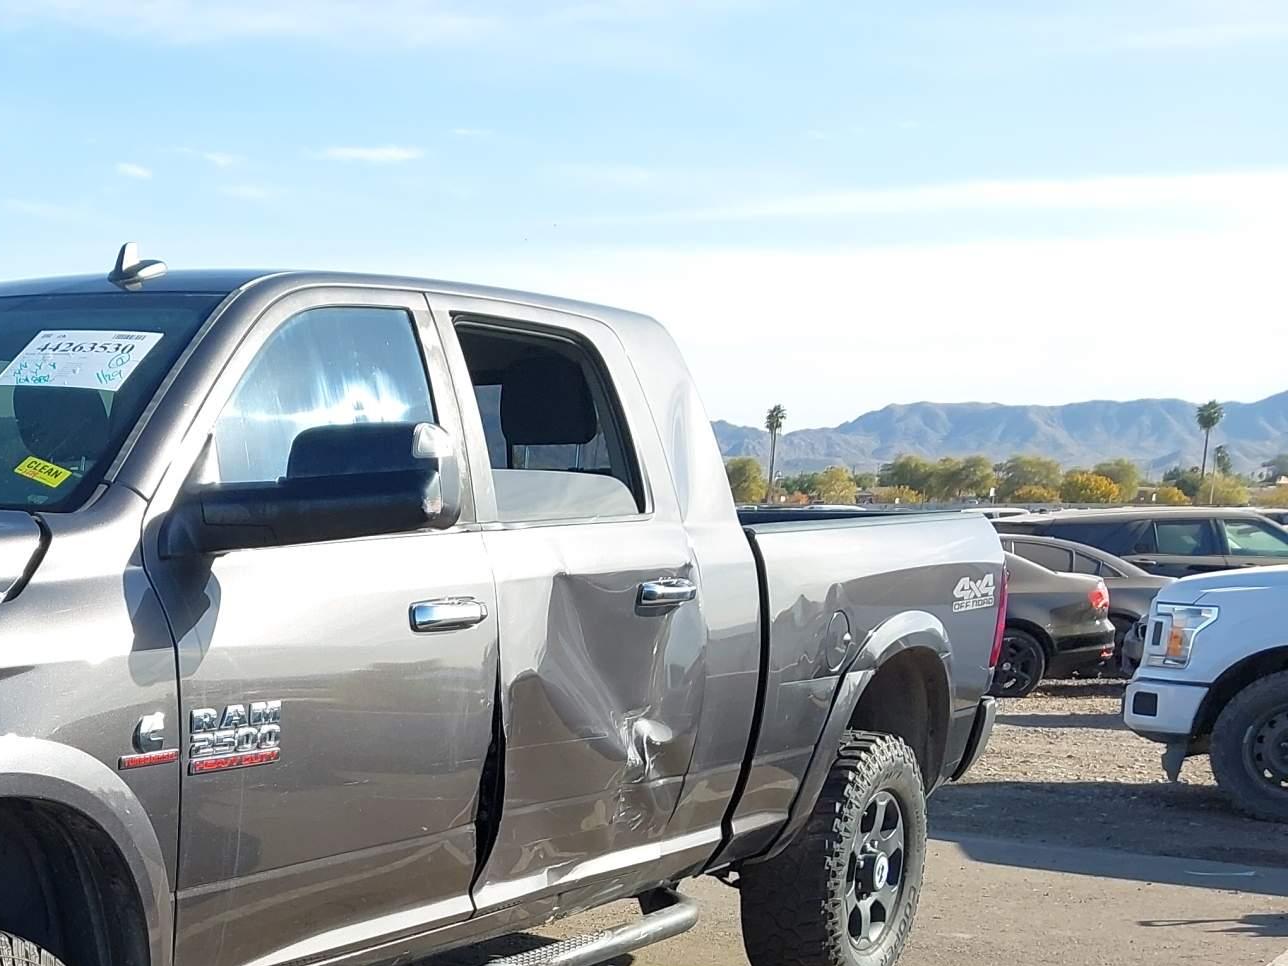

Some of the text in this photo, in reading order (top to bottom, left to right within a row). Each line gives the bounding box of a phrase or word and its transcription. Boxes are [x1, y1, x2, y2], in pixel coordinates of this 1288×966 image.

[37, 342, 135, 354] 44263530
[26, 460, 63, 479] CLEAN
[190, 700, 282, 733] RAM
[190, 725, 281, 757] 2500
